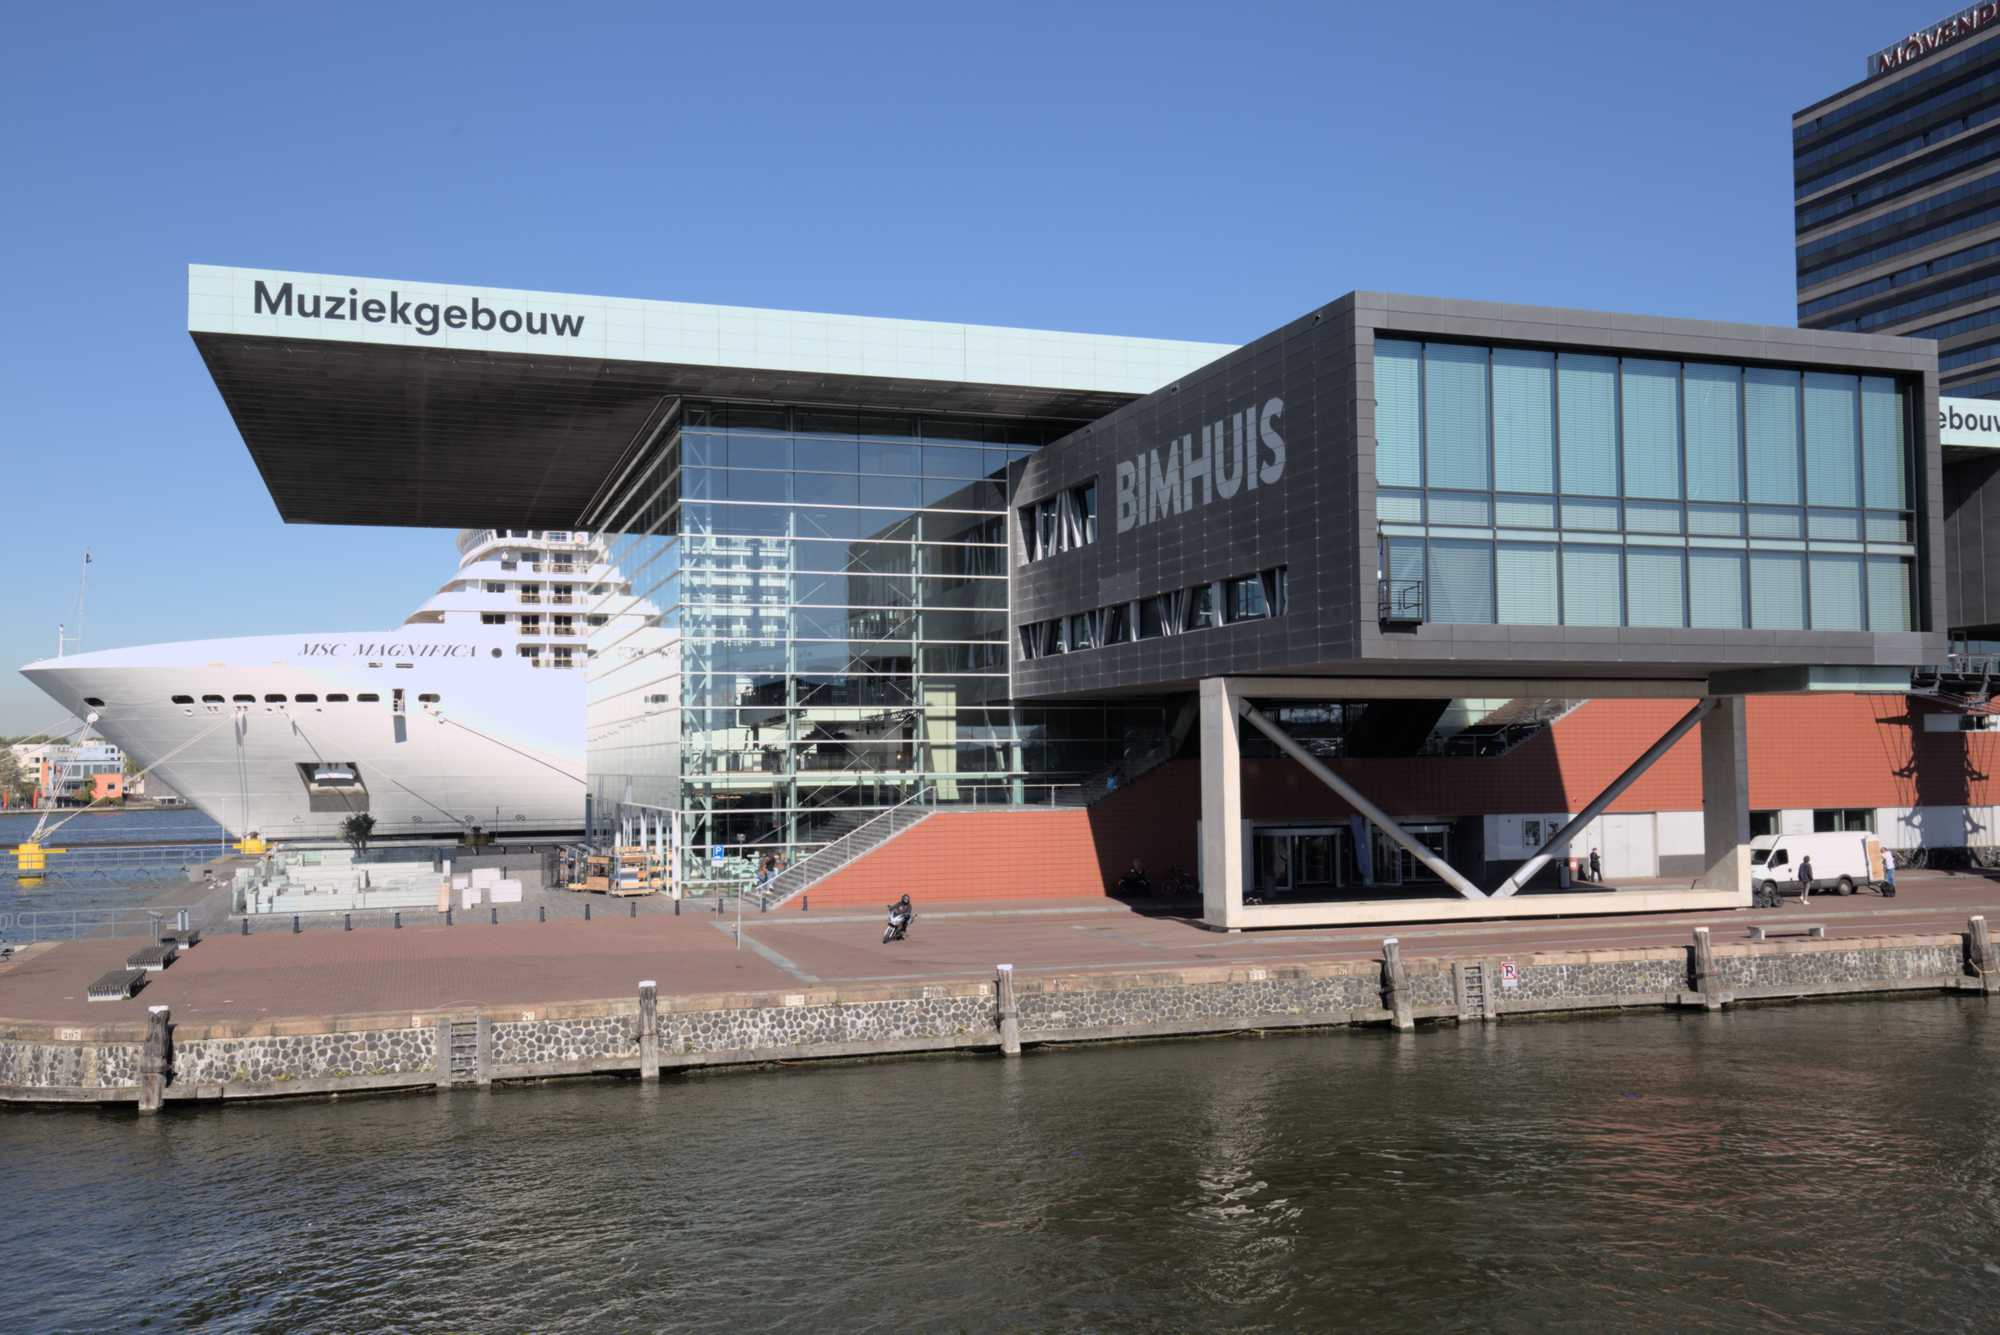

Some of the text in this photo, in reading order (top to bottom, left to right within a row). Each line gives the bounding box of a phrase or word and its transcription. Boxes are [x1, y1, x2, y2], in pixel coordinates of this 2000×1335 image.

[254, 280, 584, 337] Muziekgebouw
[1116, 397, 1286, 534] BIMHUIS
[299, 643, 476, 657] MSC MAGNIFICA
